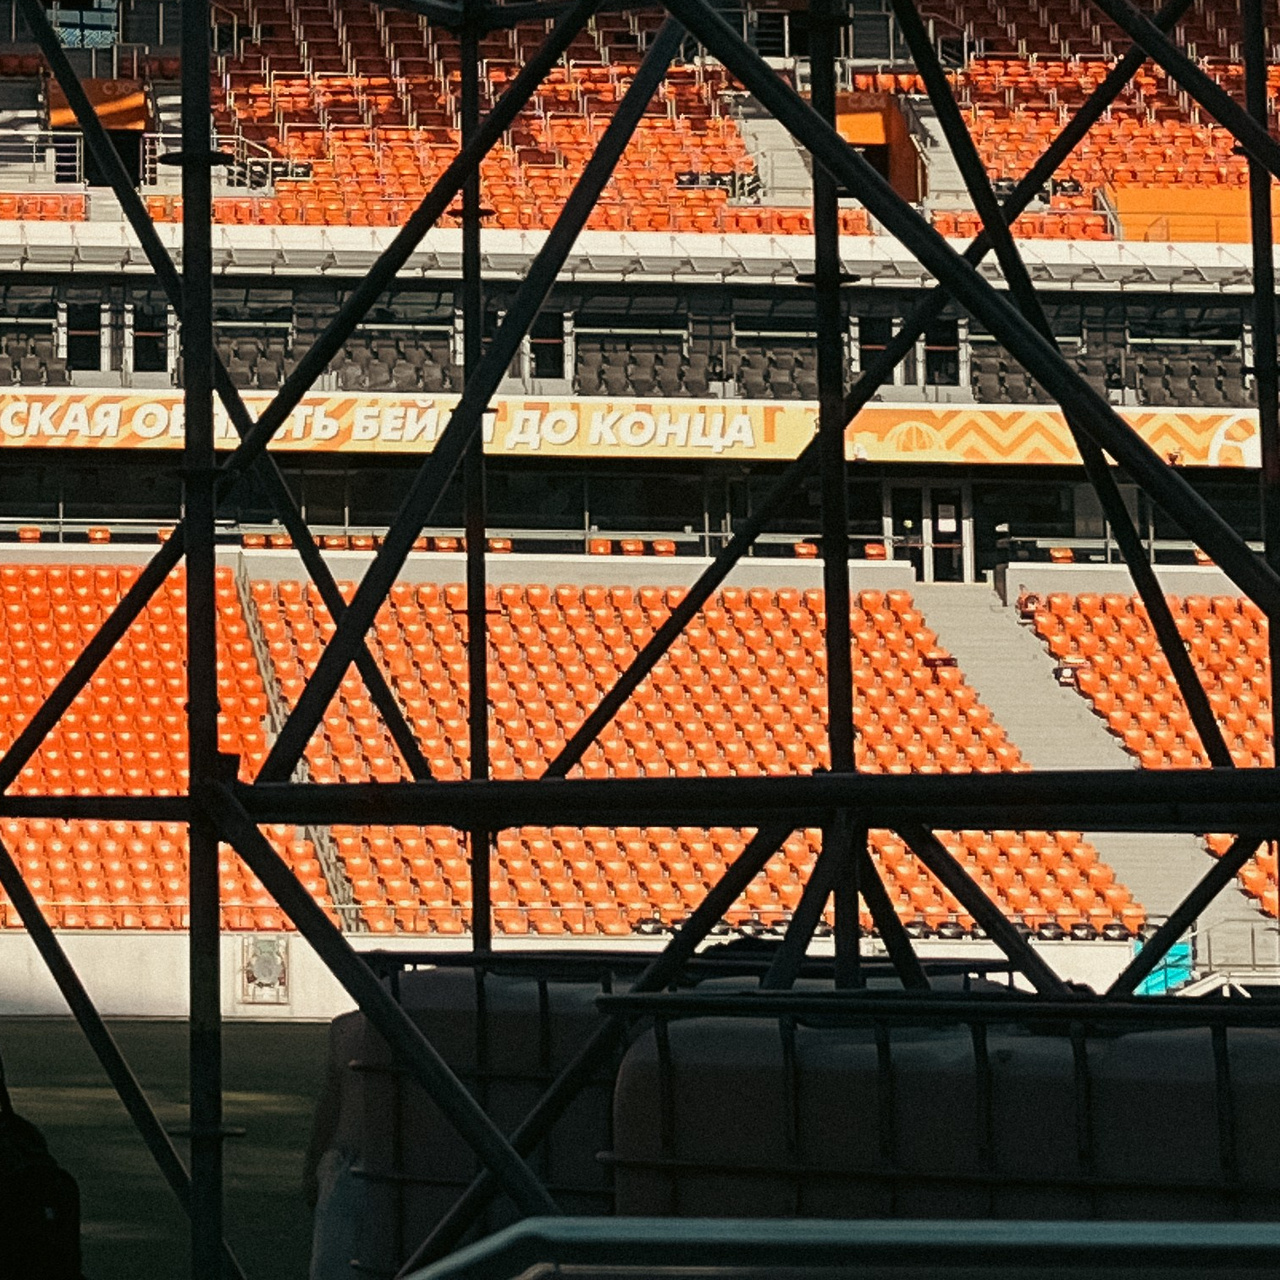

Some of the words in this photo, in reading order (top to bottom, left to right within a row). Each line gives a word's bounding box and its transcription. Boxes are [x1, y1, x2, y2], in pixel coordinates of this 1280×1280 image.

[352, 398, 497, 444] БЕЙ
[505, 410, 581, 451] ДО
[588, 409, 756, 453] КОНЦА
